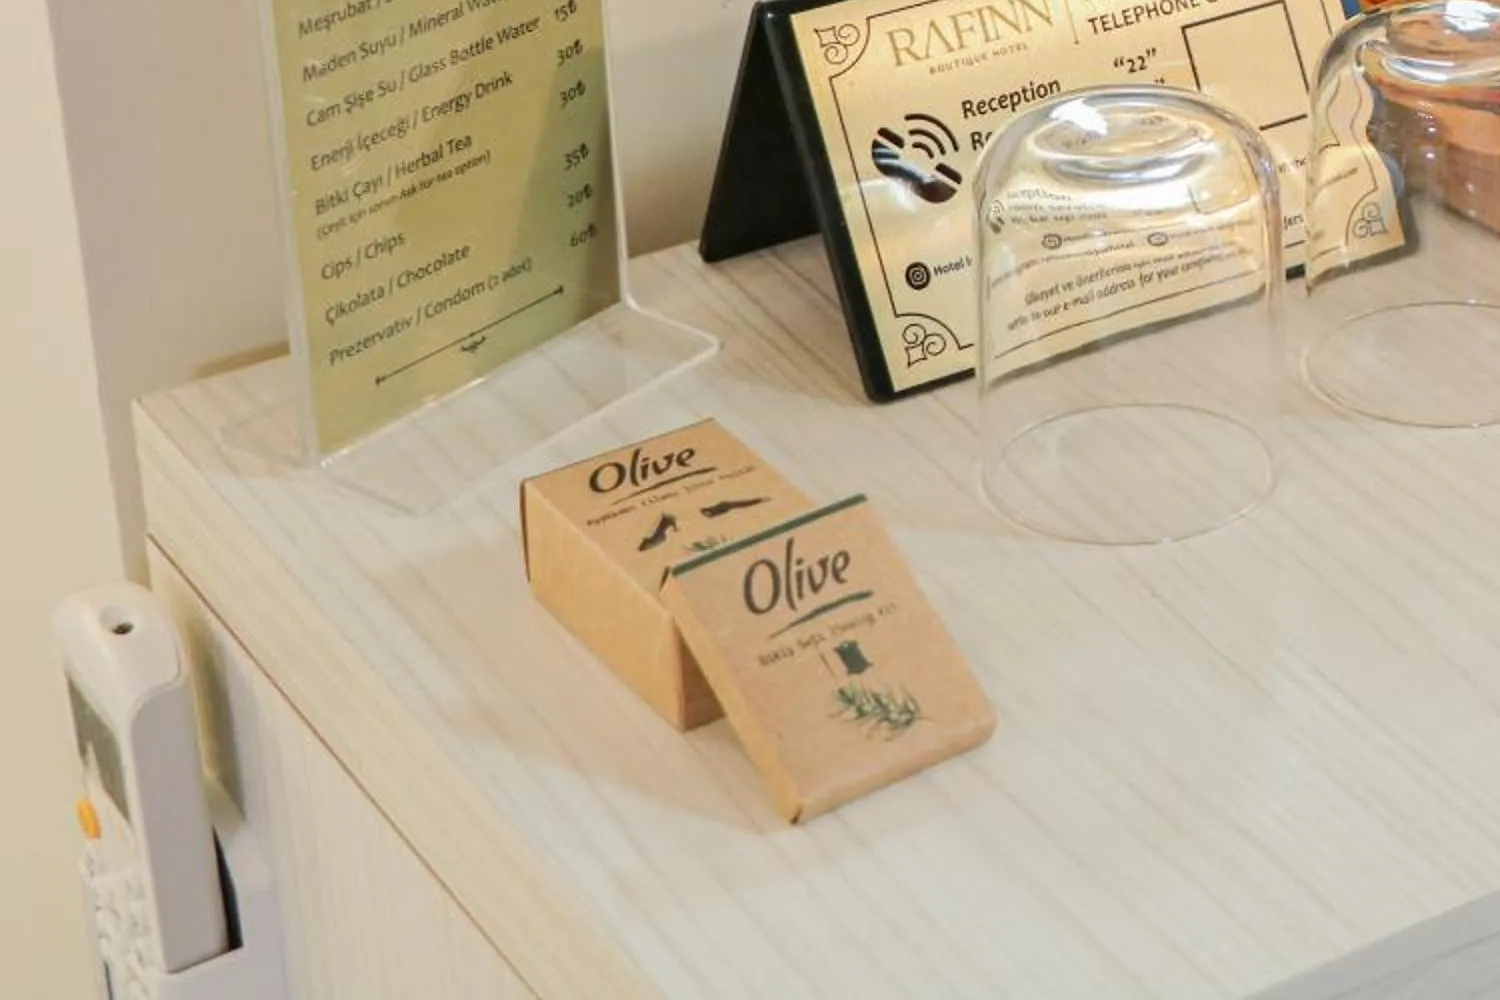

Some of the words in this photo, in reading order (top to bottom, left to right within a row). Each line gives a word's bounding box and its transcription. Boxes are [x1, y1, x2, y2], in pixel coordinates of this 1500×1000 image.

[303, 50, 356, 83] Maden
[359, 34, 397, 60] Suyu
[306, 103, 341, 127] Cam
[377, 78, 397, 98] Su
[409, 58, 446, 83] Glass
[450, 36, 494, 66] Bottle
[496, 16, 540, 45] Water
[422, 91, 472, 123] Energy
[475, 71, 513, 99] Drink
[961, 79, 1062, 119] Reception
[394, 143, 443, 177] Herbal
[446, 135, 473, 155] Tea
[365, 232, 406, 260] Chips
[325, 285, 385, 327] Çikolata
[397, 245, 471, 288] Chocolate
[933, 261, 966, 278] Hotel
[425, 280, 485, 319] Condom
[589, 447, 696, 493] Olive
[744, 536, 851, 616] Olive
